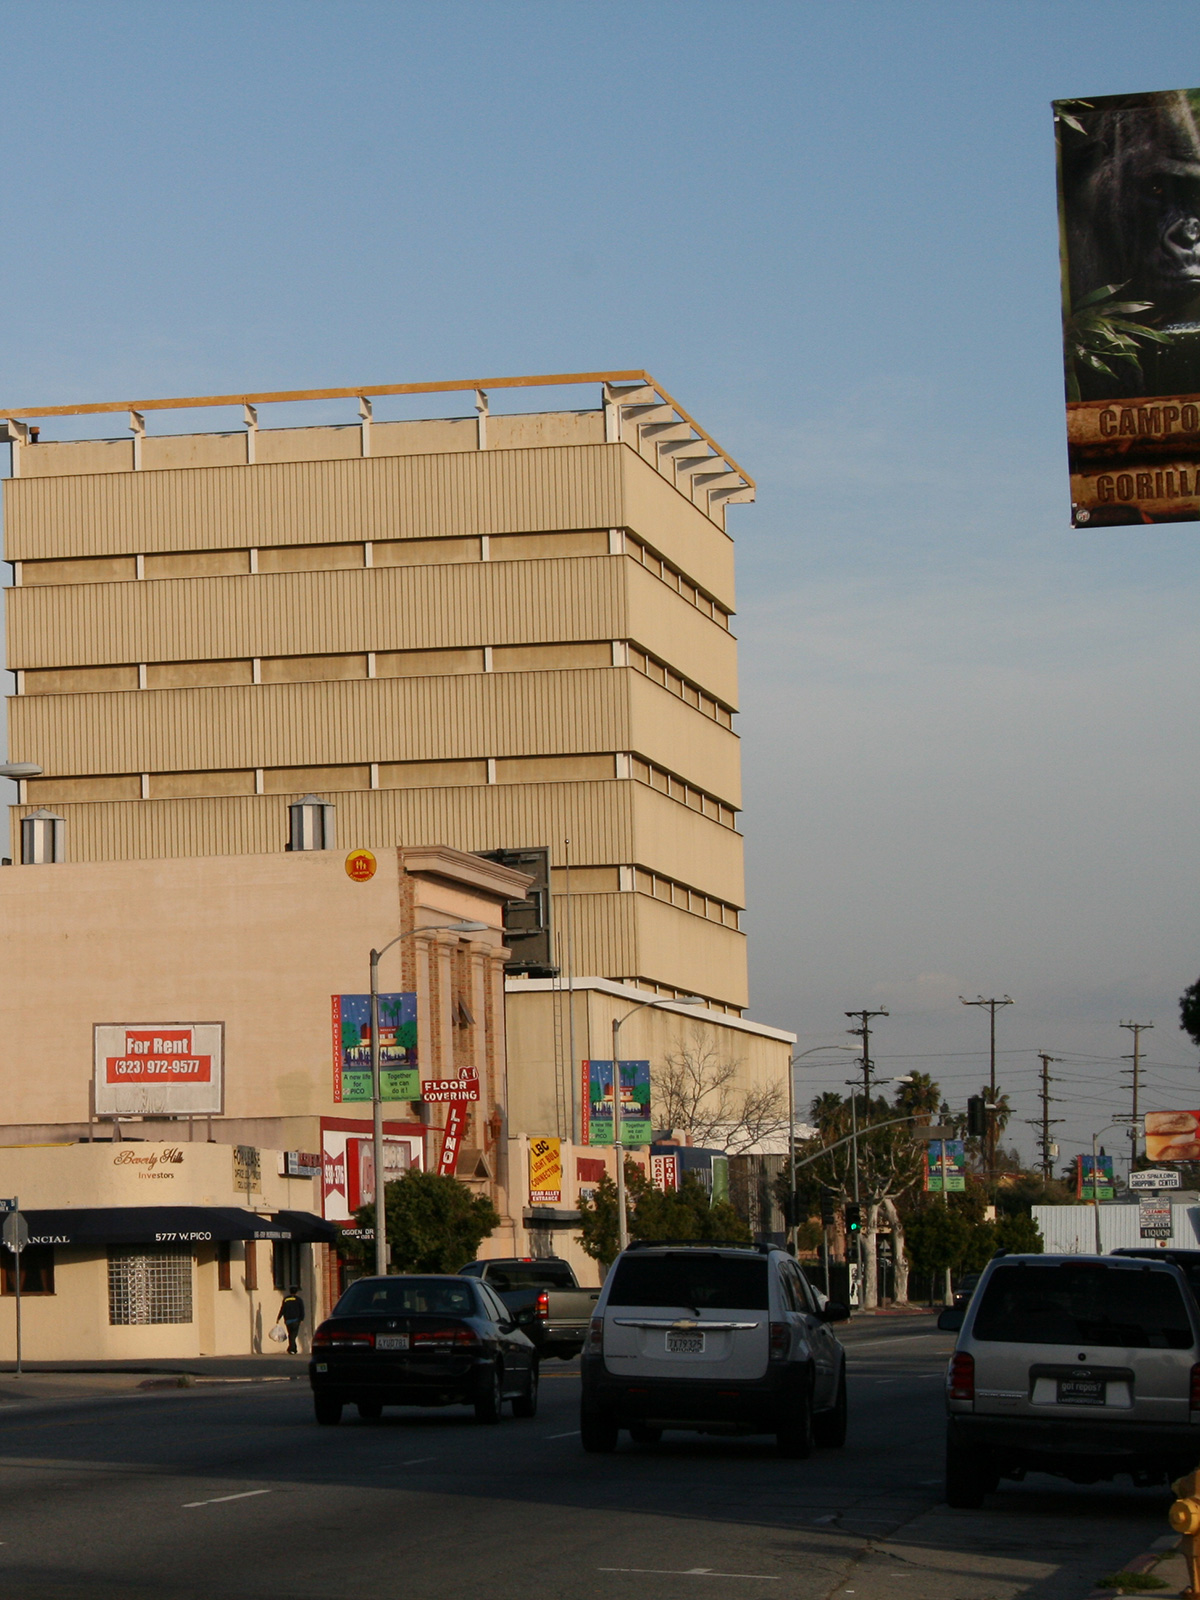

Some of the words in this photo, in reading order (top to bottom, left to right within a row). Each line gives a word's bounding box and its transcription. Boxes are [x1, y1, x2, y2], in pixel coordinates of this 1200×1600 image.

[1099, 405, 1199, 437] CAMPO
[127, 1038, 150, 1054] For
[153, 1038, 188, 1054] Rent
[115, 1060, 144, 1075] (323)
[147, 1060, 200, 1074] 972-9577
[425, 1081, 467, 1091] FLOOR
[424, 1091, 477, 1101] COVERING
[440, 1108, 460, 1176] LINOL
[531, 1140, 549, 1157] LBC
[114, 1150, 157, 1170] Beverly
[160, 1148, 184, 1163] Hills
[139, 1172, 174, 1180] Investors
[531, 1164, 560, 1187] CONNECTION
[155, 1233, 176, 1241] 5777
[1062, 1383, 1074, 1391] got
[1076, 1383, 1101, 1392] repos?
